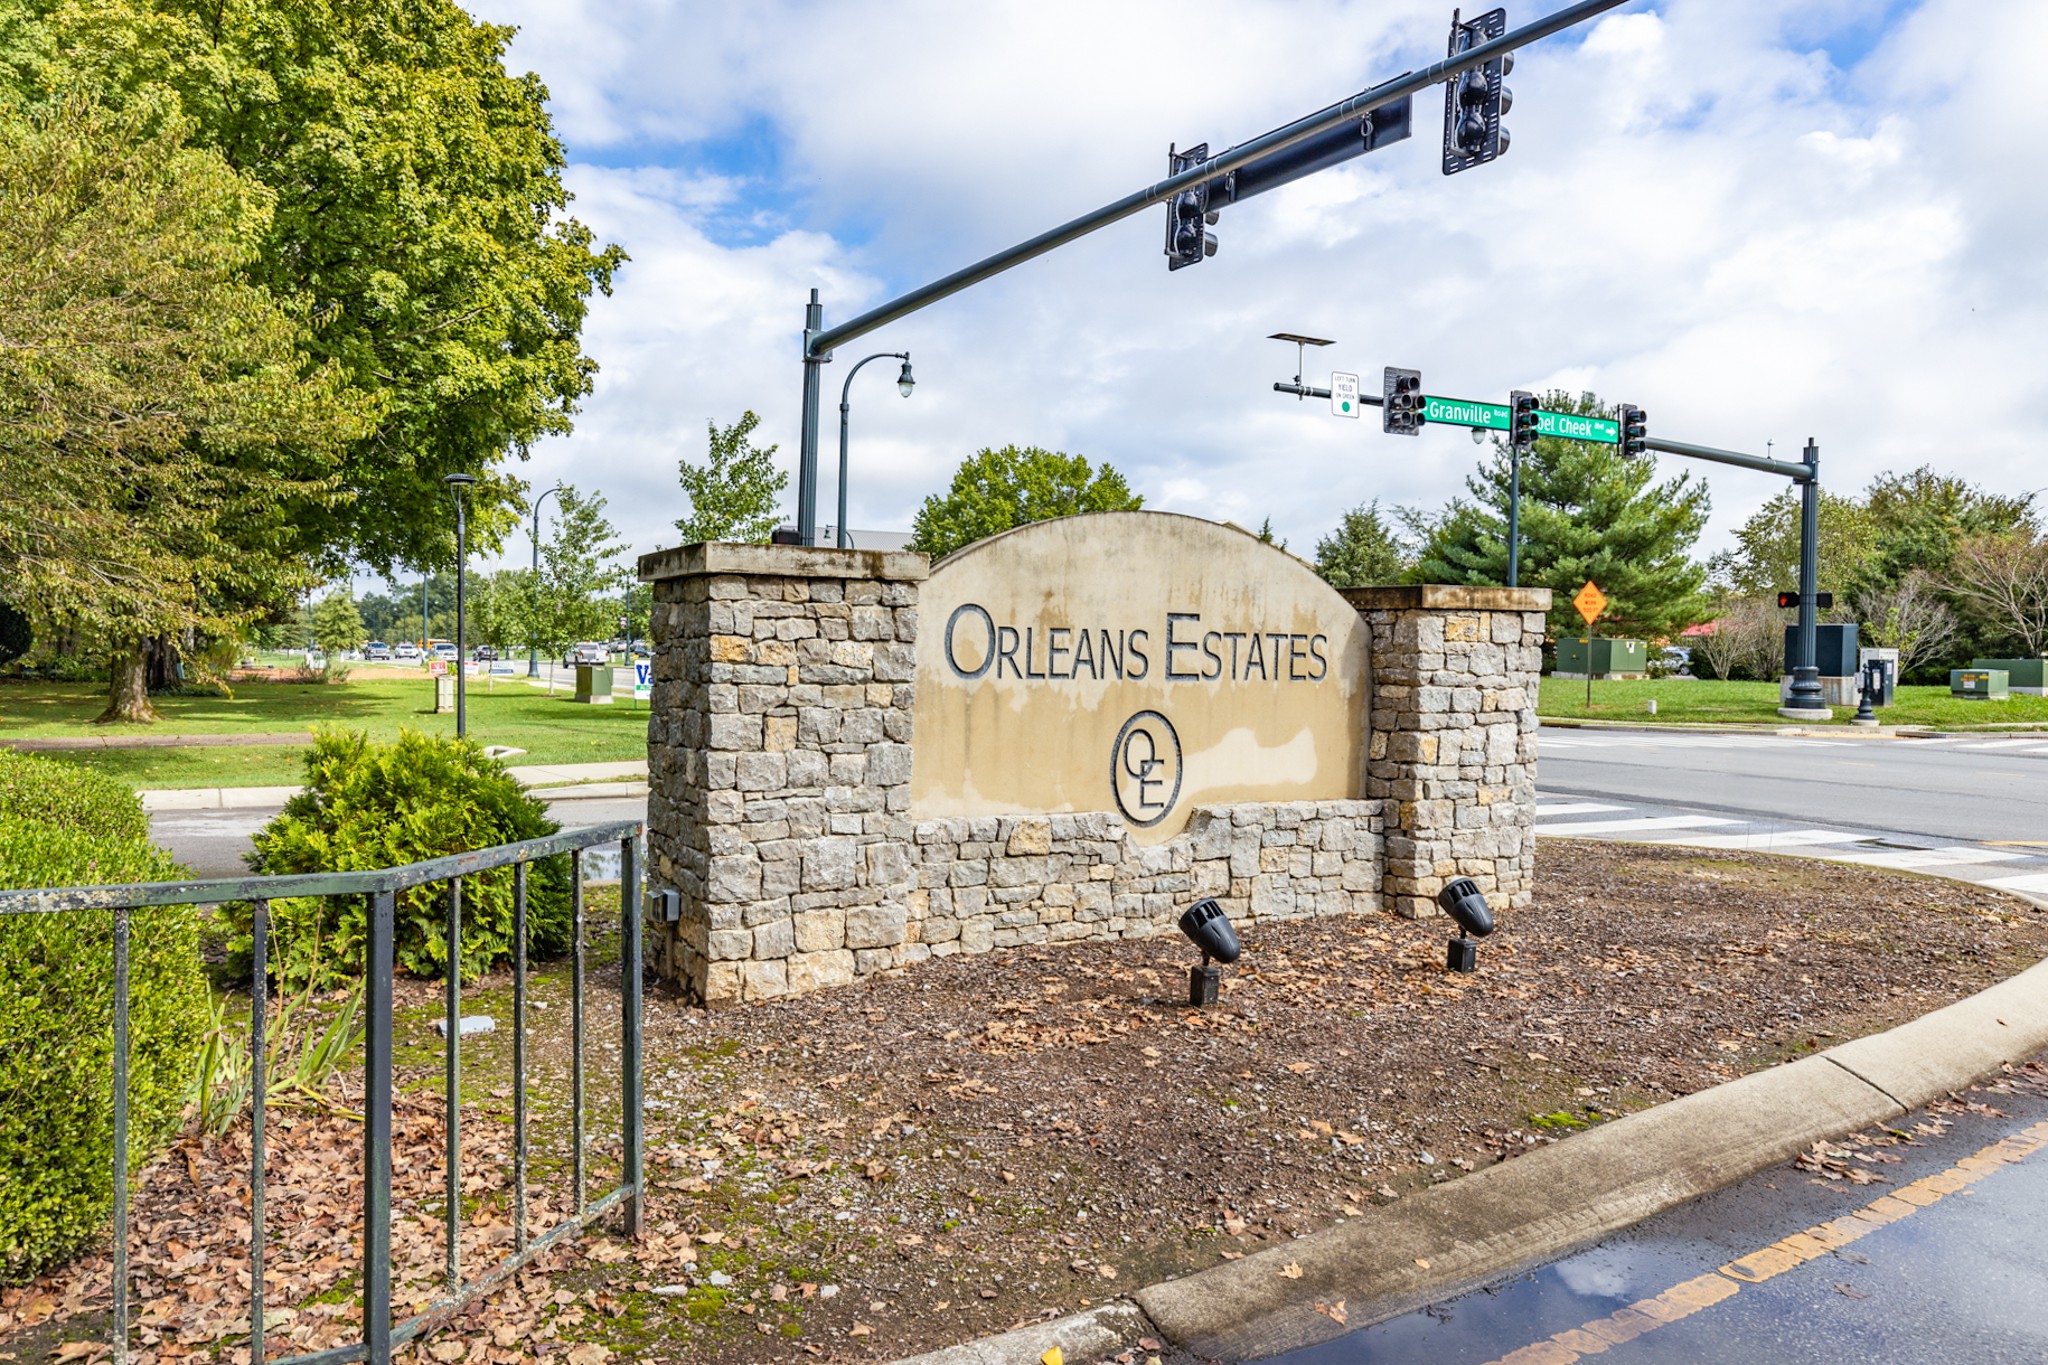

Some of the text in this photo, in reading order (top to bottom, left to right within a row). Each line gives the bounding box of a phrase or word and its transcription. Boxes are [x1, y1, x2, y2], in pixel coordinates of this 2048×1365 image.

[1338, 383, 1353, 393] YIELD
[1429, 401, 1509, 425] Granville Road
[1533, 415, 1556, 433] oel
[1558, 417, 1592, 437] Cheek
[944, 602, 1329, 682] ORLEANS ESTATES
